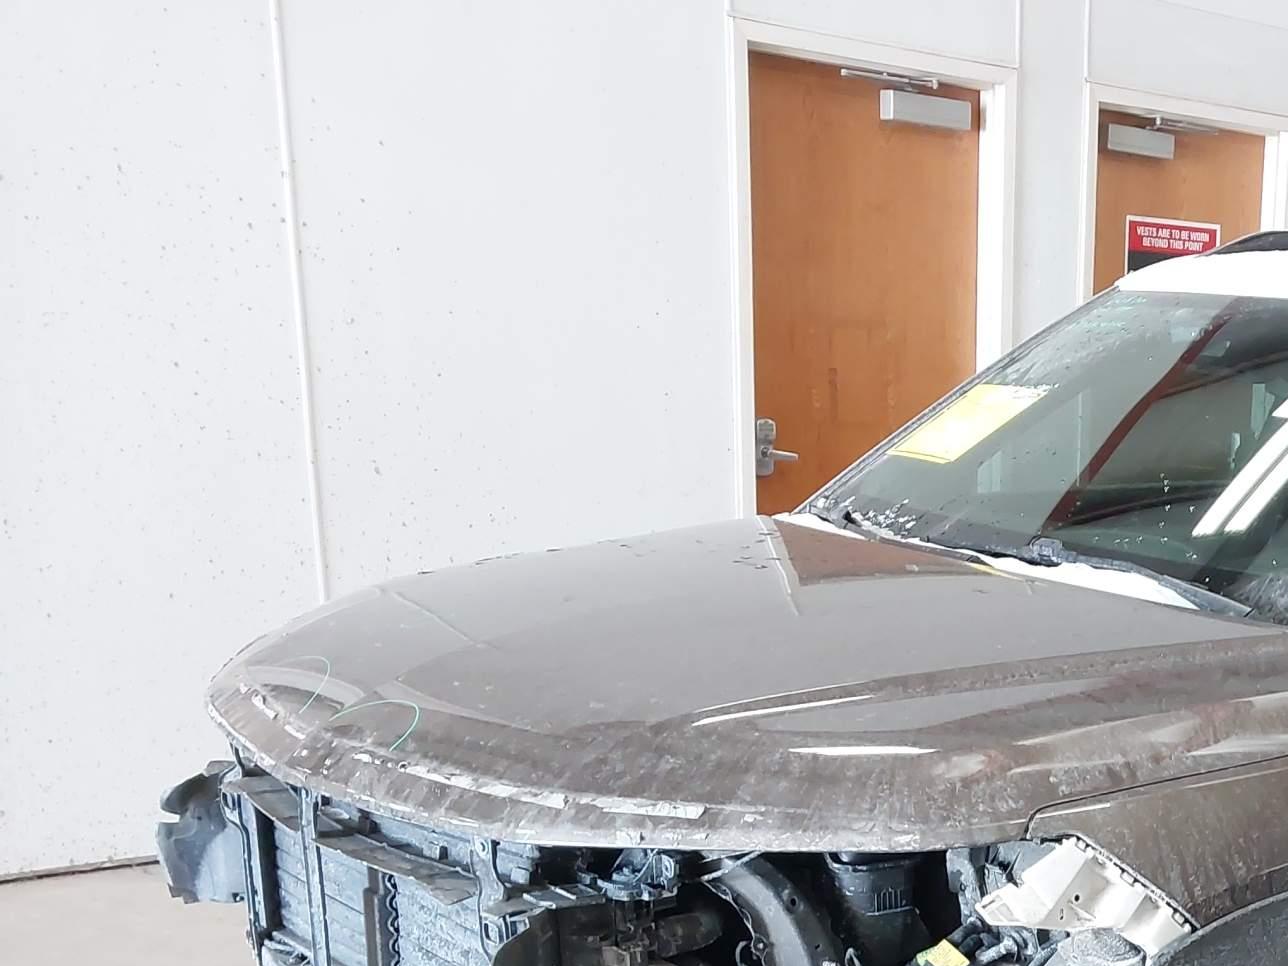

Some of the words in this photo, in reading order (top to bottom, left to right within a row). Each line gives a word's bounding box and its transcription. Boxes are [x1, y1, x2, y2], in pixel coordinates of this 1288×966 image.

[1136, 226, 1157, 237] VESTS
[1157, 228, 1171, 239] ARE
[1172, 230, 1180, 240] TO
[1180, 231, 1190, 241] BE
[1190, 232, 1210, 243] WORN
[1142, 237, 1169, 249] BEYOND
[1169, 239, 1184, 250] THIS
[1184, 241, 1204, 252] POINT
